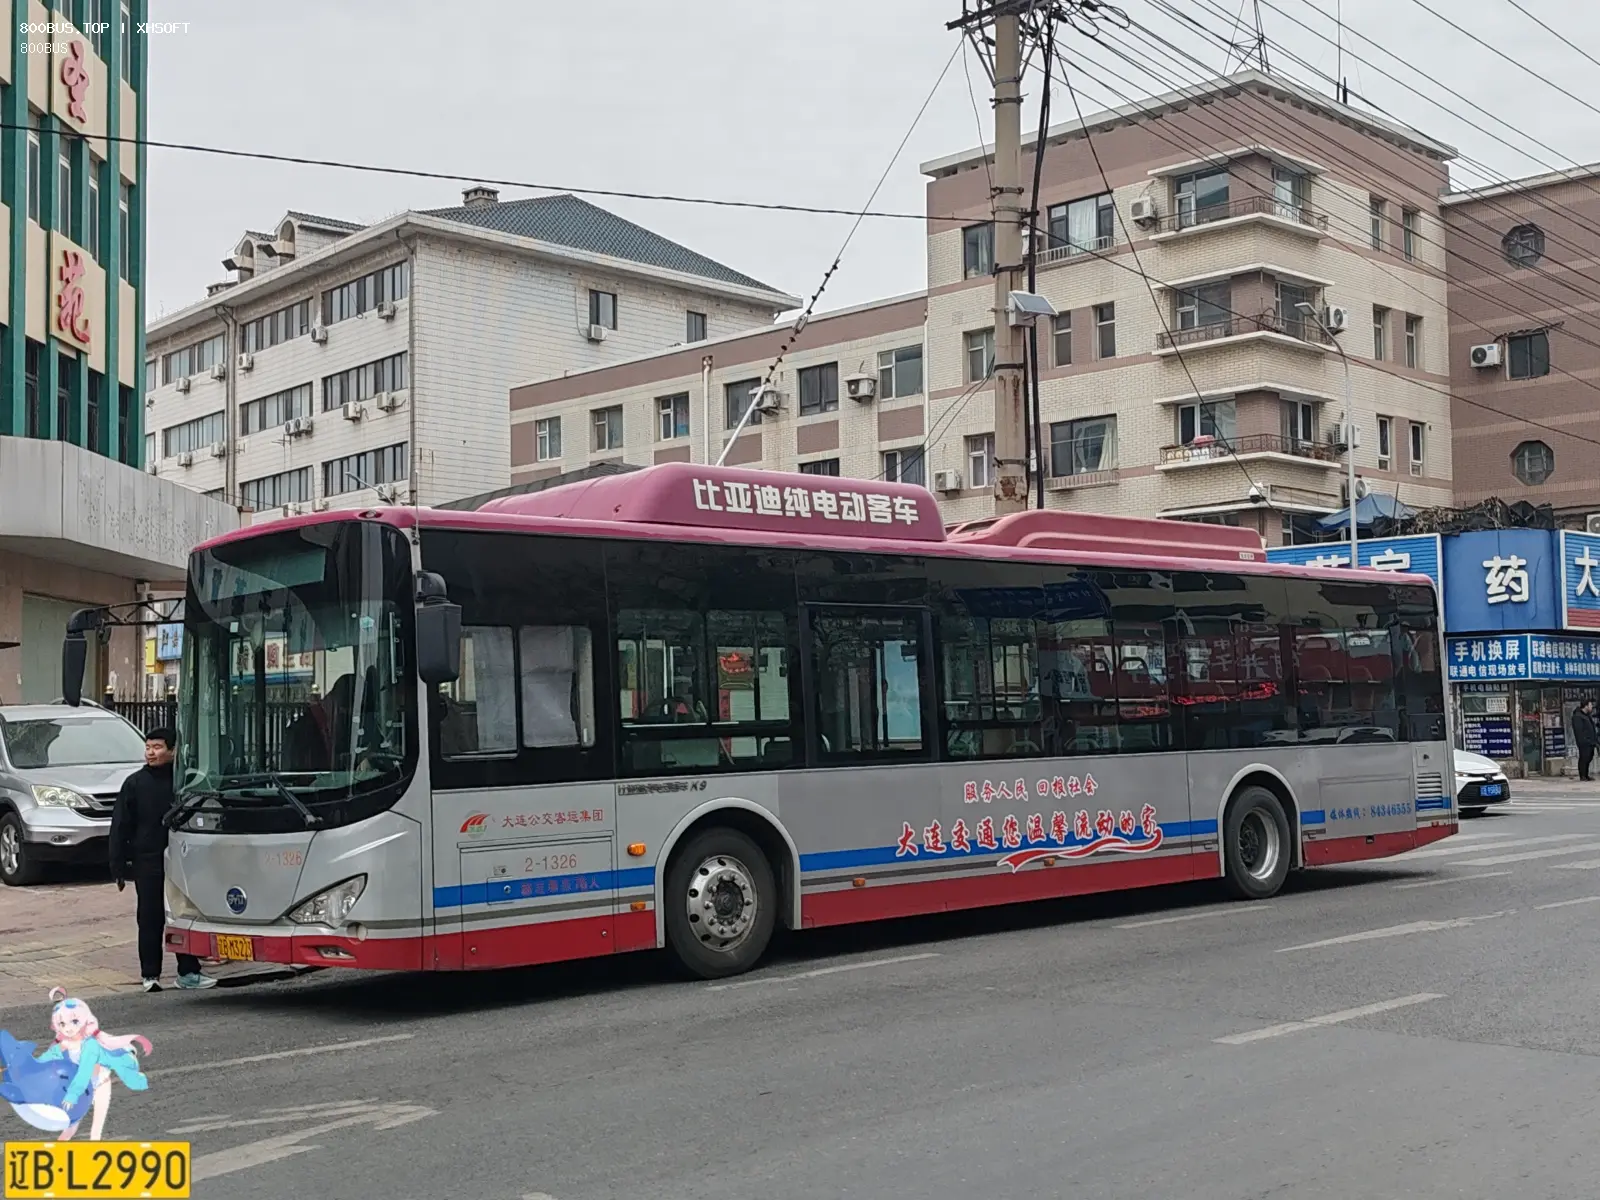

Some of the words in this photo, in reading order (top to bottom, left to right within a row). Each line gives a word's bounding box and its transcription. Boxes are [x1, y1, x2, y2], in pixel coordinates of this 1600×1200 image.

[692, 478, 920, 525] 比亚迪纯电动客车
[1482, 554, 1530, 604] 药
[1574, 545, 1600, 597] 大
[1454, 639, 1521, 662] 手机换屏
[1449, 662, 1527, 678] 联通电信现场放号
[964, 778, 1029, 804] 服务人民
[1036, 773, 1098, 799] 回报社会
[501, 809, 604, 829] 大连公交客运集团
[896, 803, 1160, 857] 大连交通您温馨流动的家
[264, 851, 302, 866] 2-1326
[524, 853, 578, 873] 2-1326
